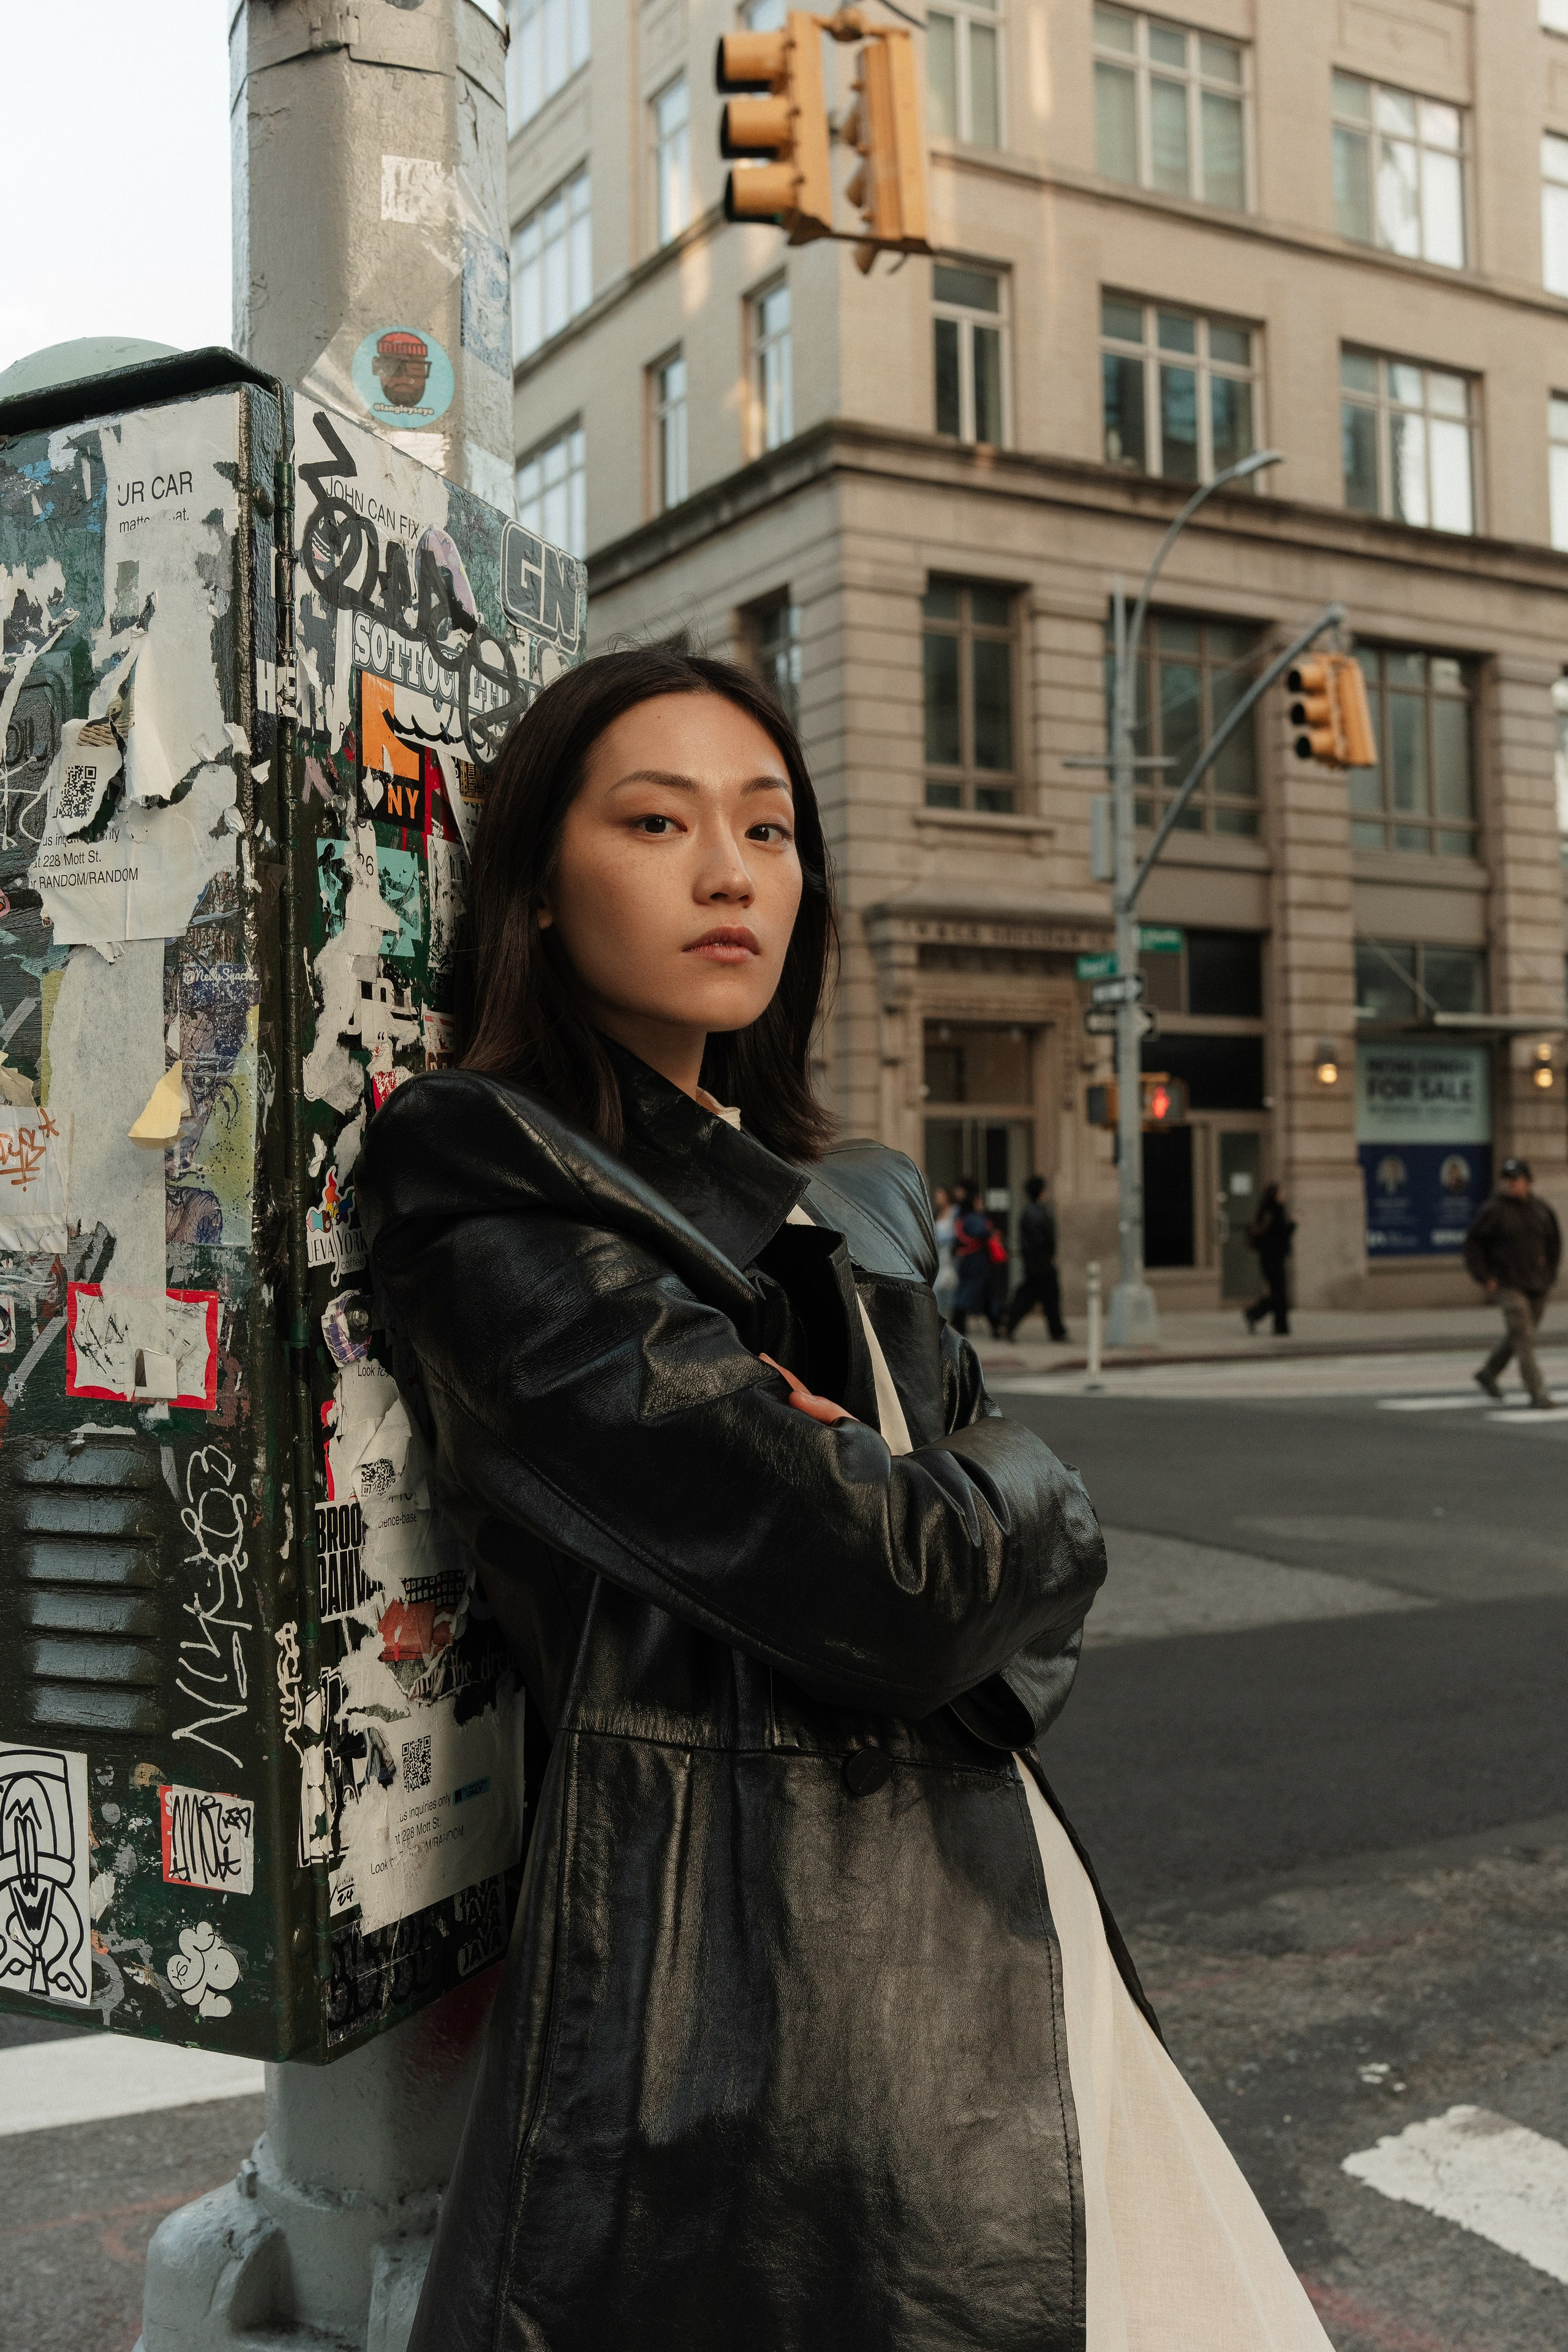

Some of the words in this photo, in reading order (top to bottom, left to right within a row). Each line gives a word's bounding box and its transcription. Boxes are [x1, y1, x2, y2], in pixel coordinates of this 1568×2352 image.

[151, 471, 193, 500] CAR
[326, 477, 364, 513] JOHN
[368, 498, 395, 531] CAN
[400, 514, 420, 540] FIX
[388, 783, 419, 820] NY
[43, 854, 61, 868] 228
[64, 852, 85, 866] Mott
[88, 850, 102, 863] St.
[39, 867, 138, 889] RANDOM/RANDOM
[1366, 1077, 1414, 1098] FOR
[1422, 1079, 1472, 1099] SALE
[336, 1229, 368, 1256] YORK
[341, 1256, 364, 1270] coffee
[358, 1364, 375, 1377] Look
[315, 1502, 366, 1556] BROO
[467, 1785, 483, 1798] ONLY
[409, 1800, 437, 1819] inquiries
[438, 1792, 451, 1807] only
[402, 1826, 415, 1842] 228
[417, 1820, 431, 1836] Mott
[432, 1816, 441, 1830] St.
[371, 1858, 388, 1875] Look
